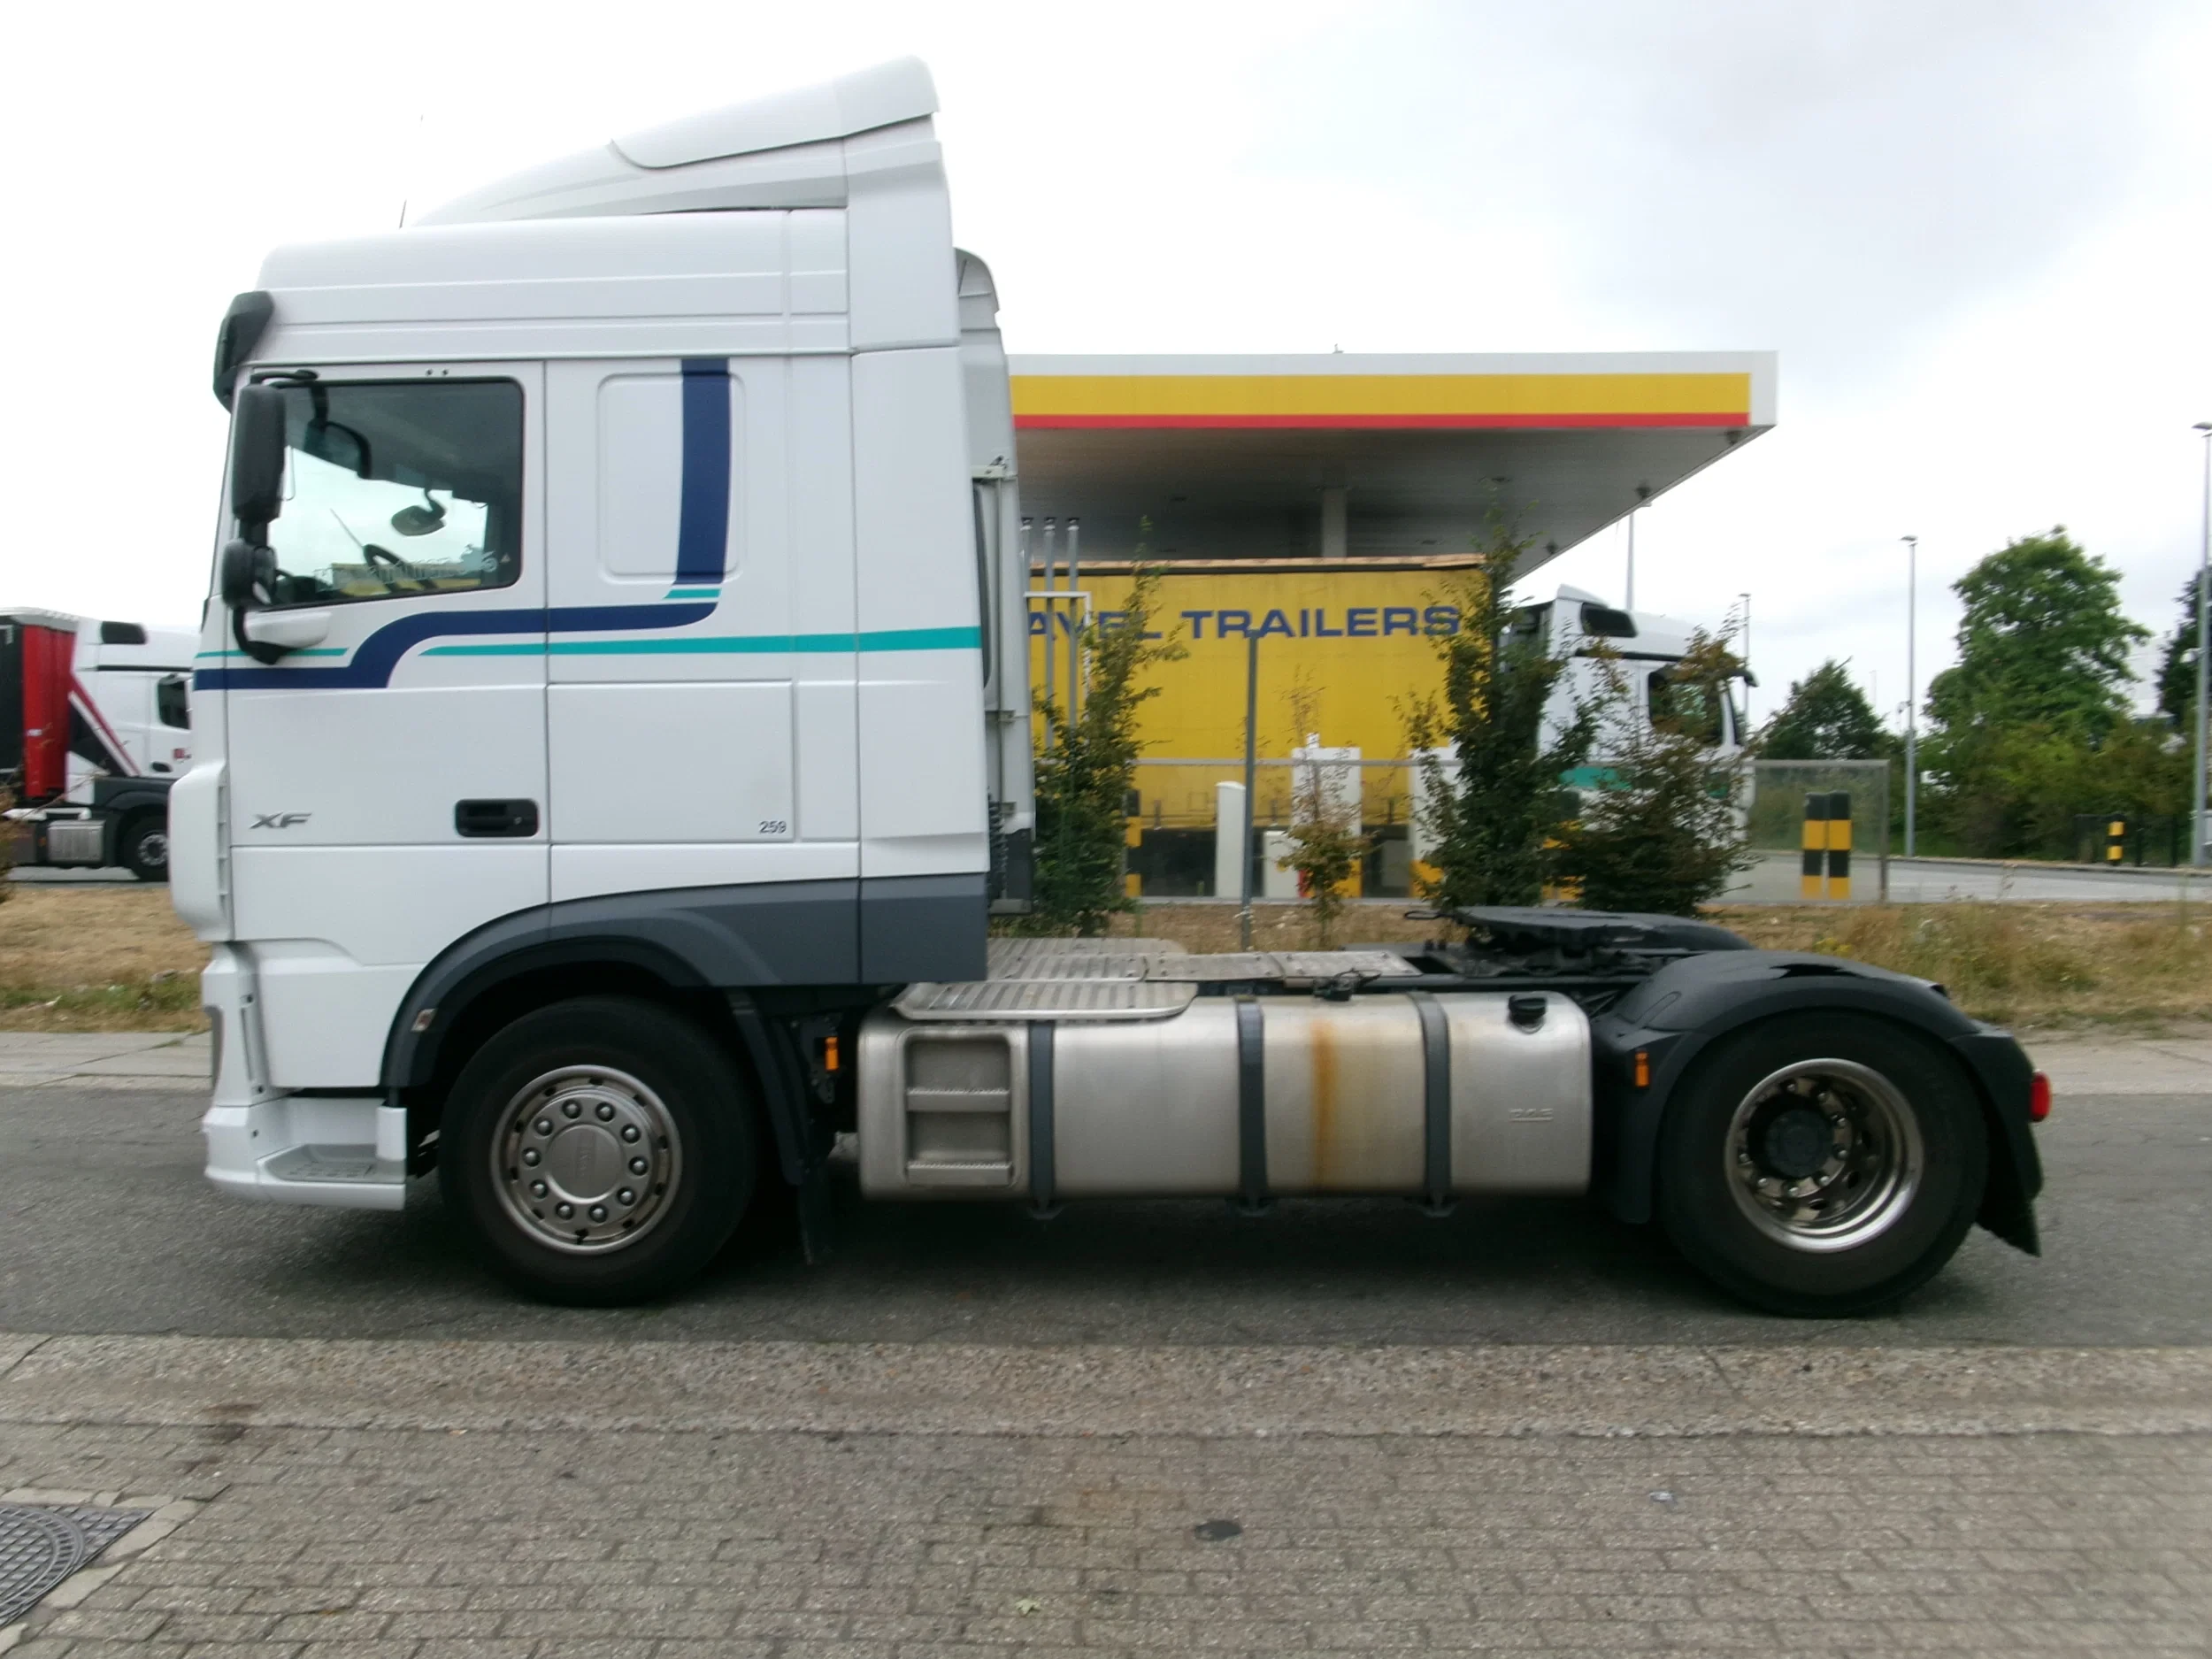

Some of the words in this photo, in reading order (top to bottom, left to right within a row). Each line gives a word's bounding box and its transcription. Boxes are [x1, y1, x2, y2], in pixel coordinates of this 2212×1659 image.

[1181, 605, 1462, 640] TRAILERS
[249, 810, 312, 829] XF
[759, 820, 787, 833] 259
